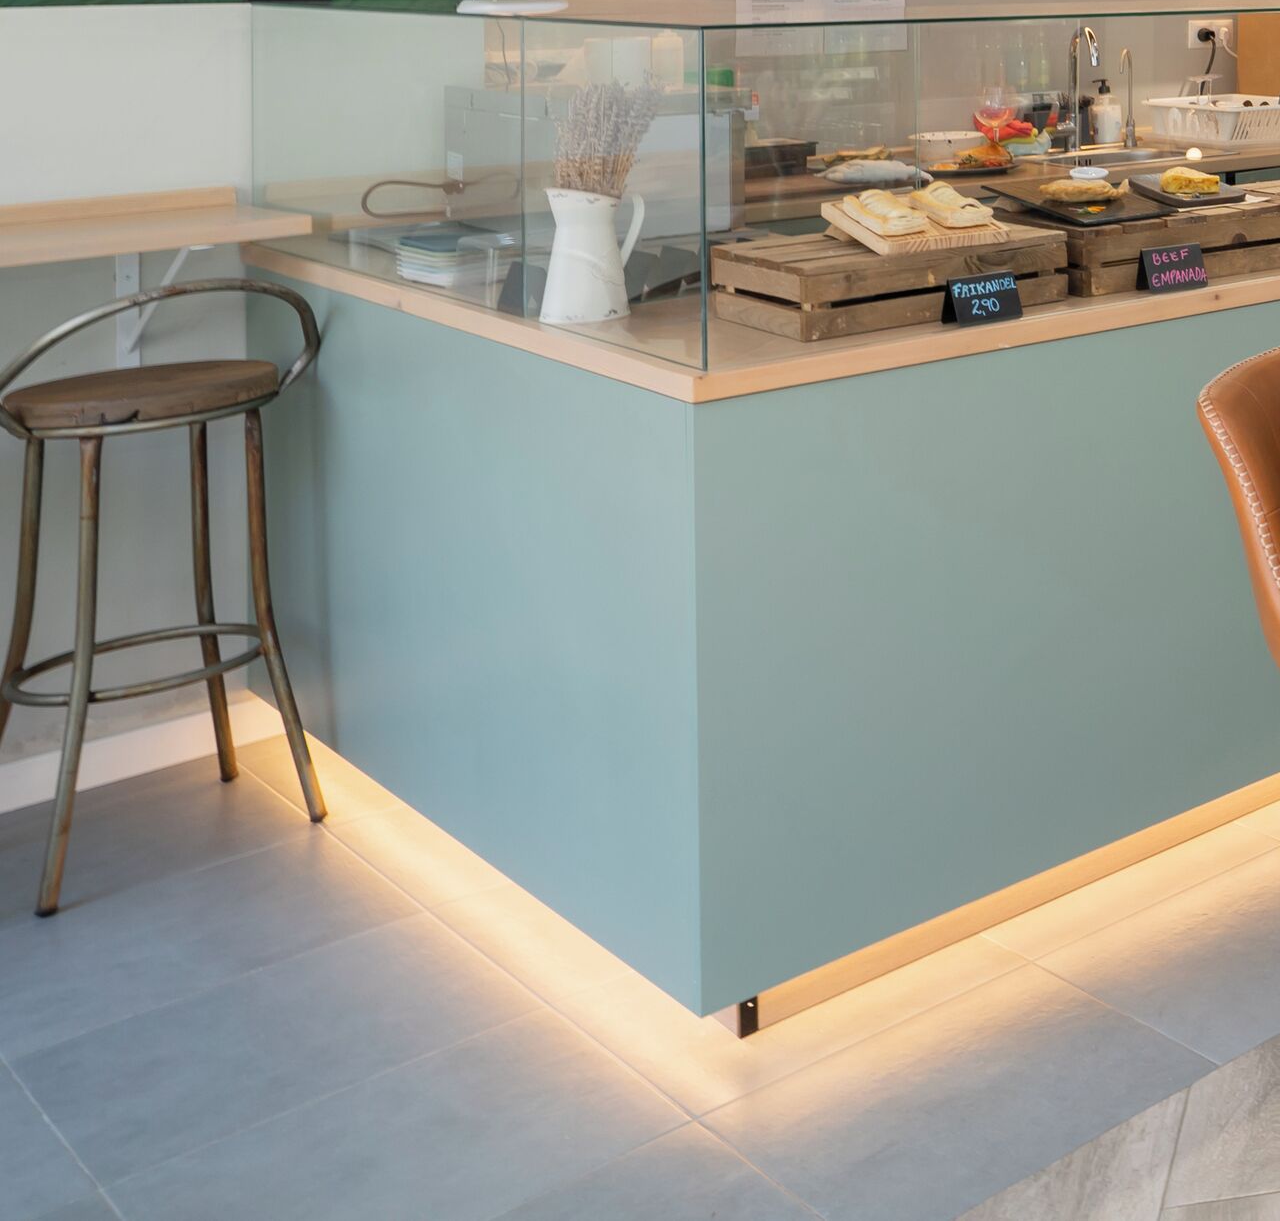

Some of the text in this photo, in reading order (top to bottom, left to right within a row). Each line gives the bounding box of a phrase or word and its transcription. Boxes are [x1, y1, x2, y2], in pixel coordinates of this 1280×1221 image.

[1152, 248, 1189, 266] BEEF
[1151, 266, 1207, 287] EMPANADA
[952, 276, 1017, 298] FRIKANDEL
[971, 296, 999, 316] 2,90
